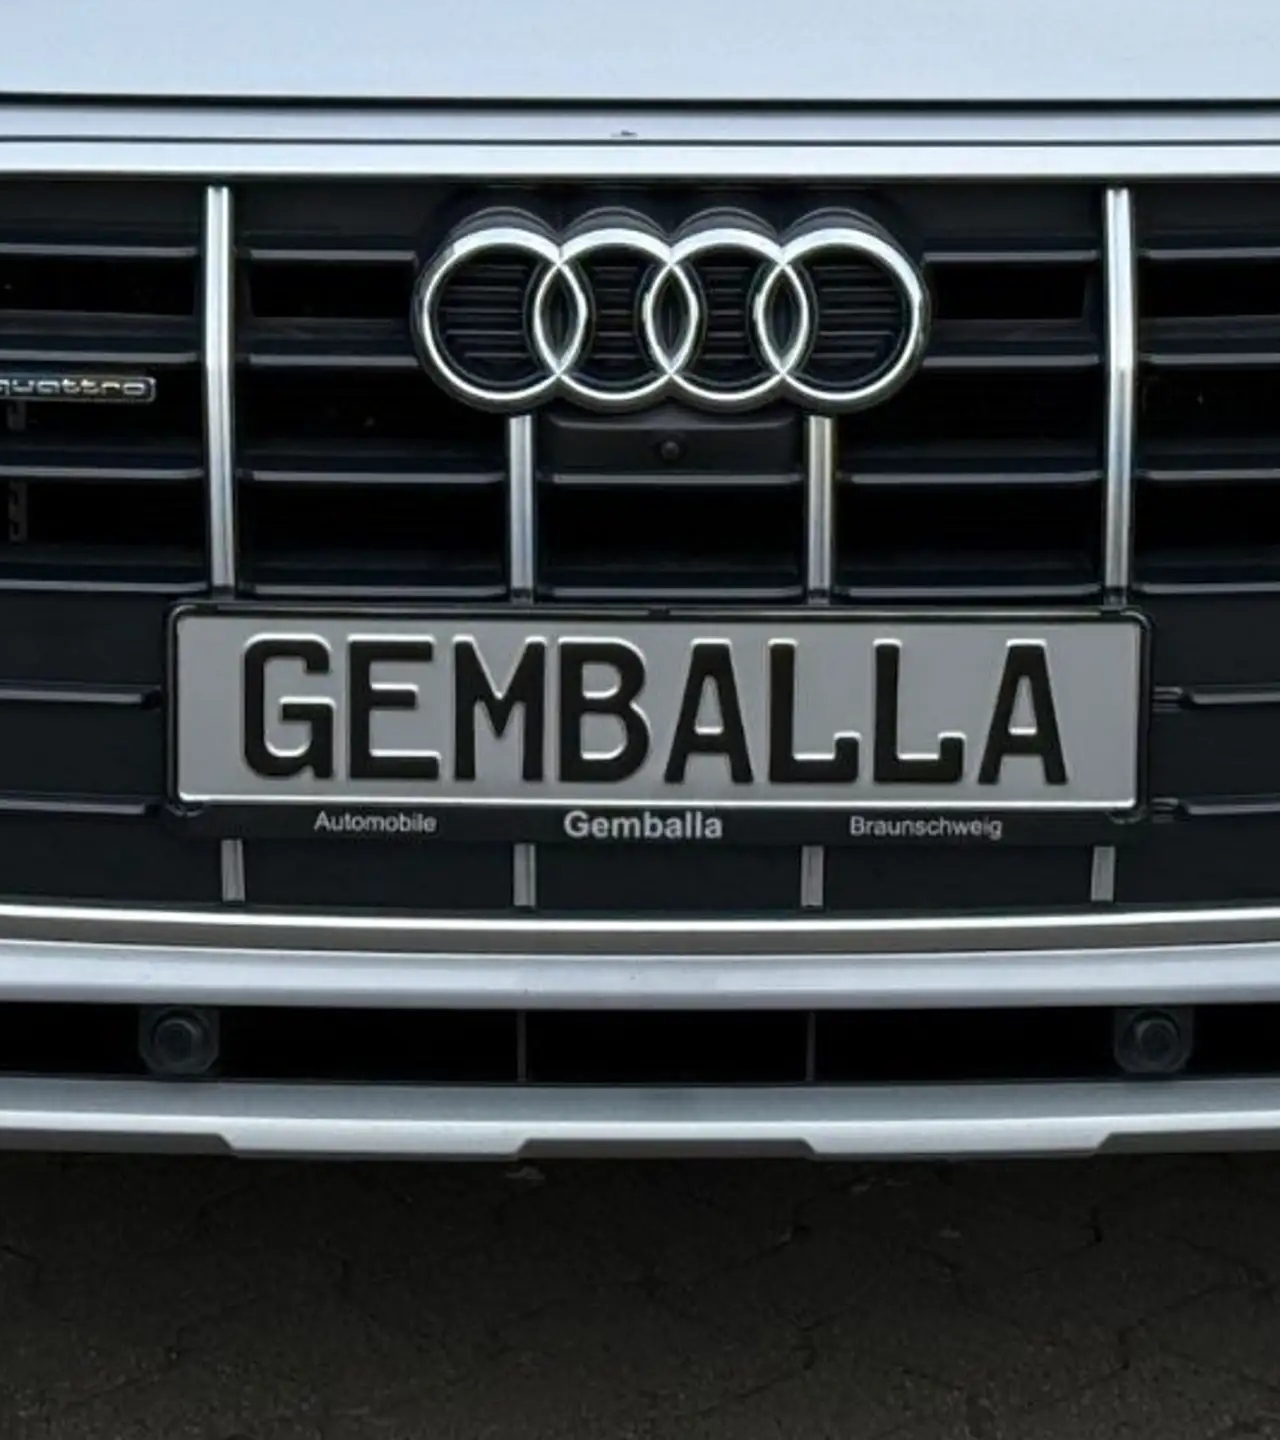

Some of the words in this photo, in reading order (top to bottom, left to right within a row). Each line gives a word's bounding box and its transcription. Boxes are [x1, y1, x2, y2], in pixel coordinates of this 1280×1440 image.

[242, 633, 1068, 785] GEMBALLA
[313, 810, 437, 832] Automobile
[563, 810, 723, 840] Gemballa
[849, 815, 1003, 841] Braunschweig
